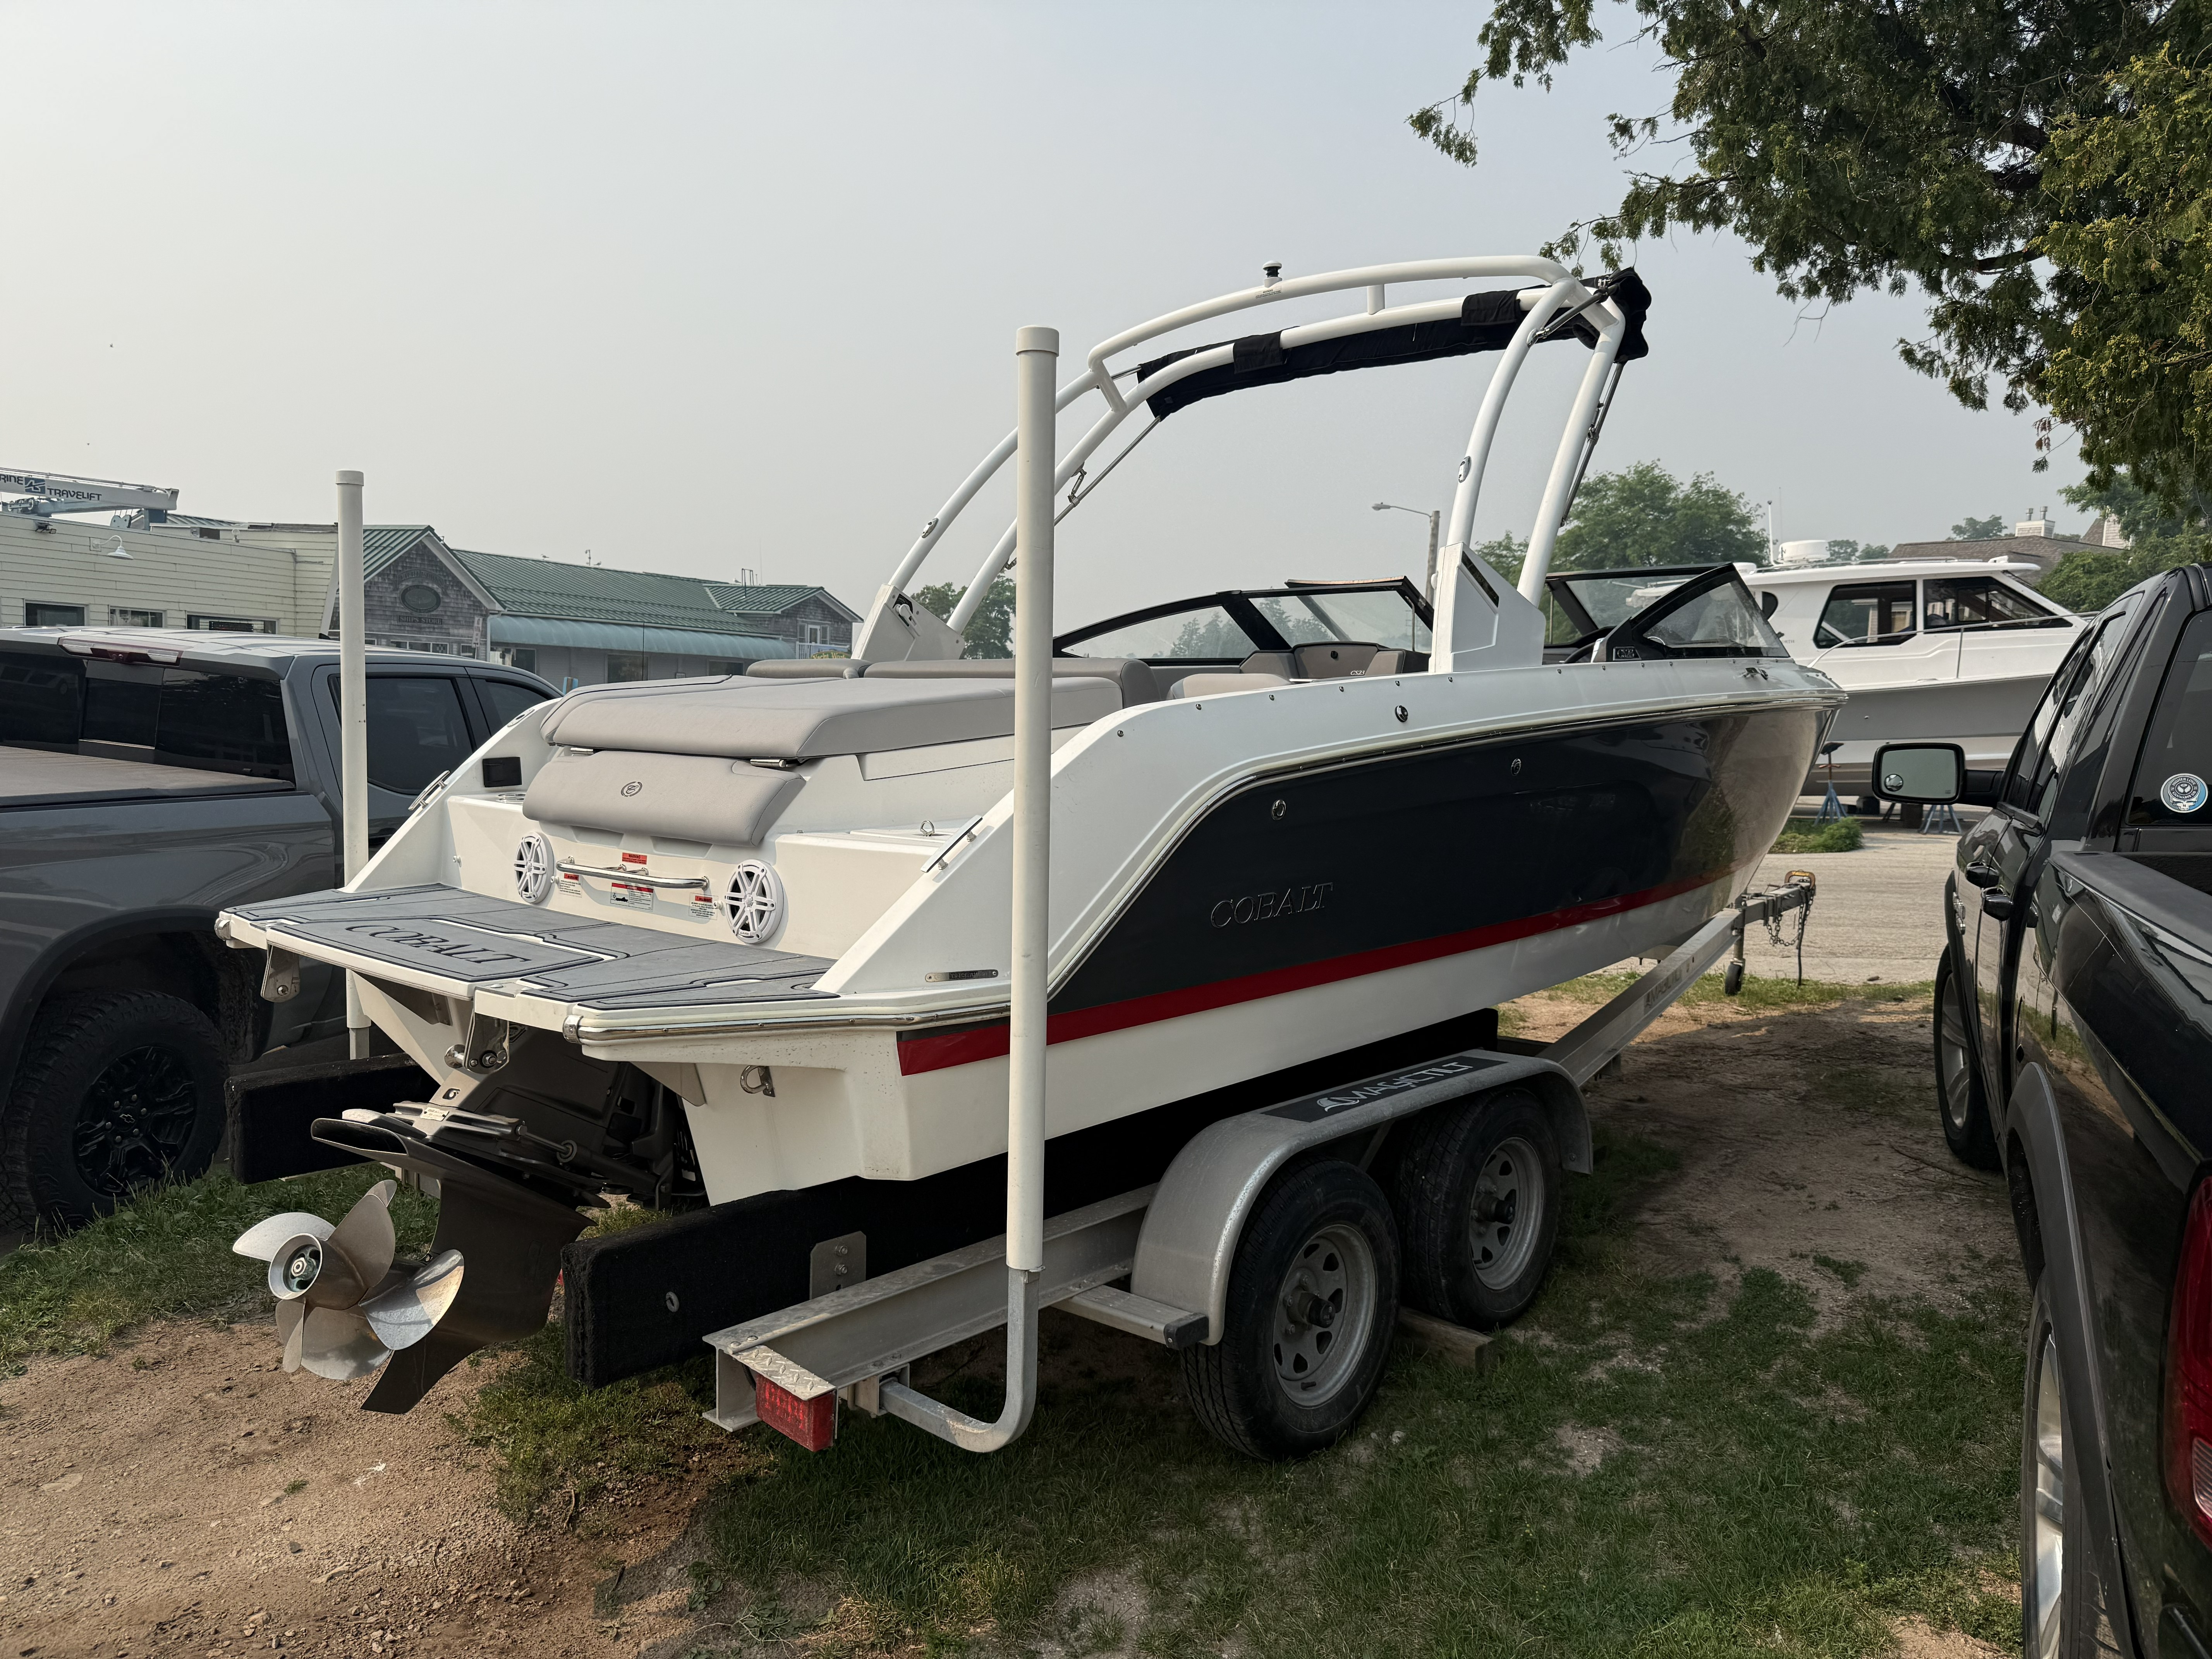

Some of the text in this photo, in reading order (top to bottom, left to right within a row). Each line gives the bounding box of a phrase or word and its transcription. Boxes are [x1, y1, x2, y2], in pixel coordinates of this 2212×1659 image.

[47, 488, 102, 501] TRAVELIFT
[1211, 883, 1333, 928] COBALT
[345, 925, 532, 963] COBALT
